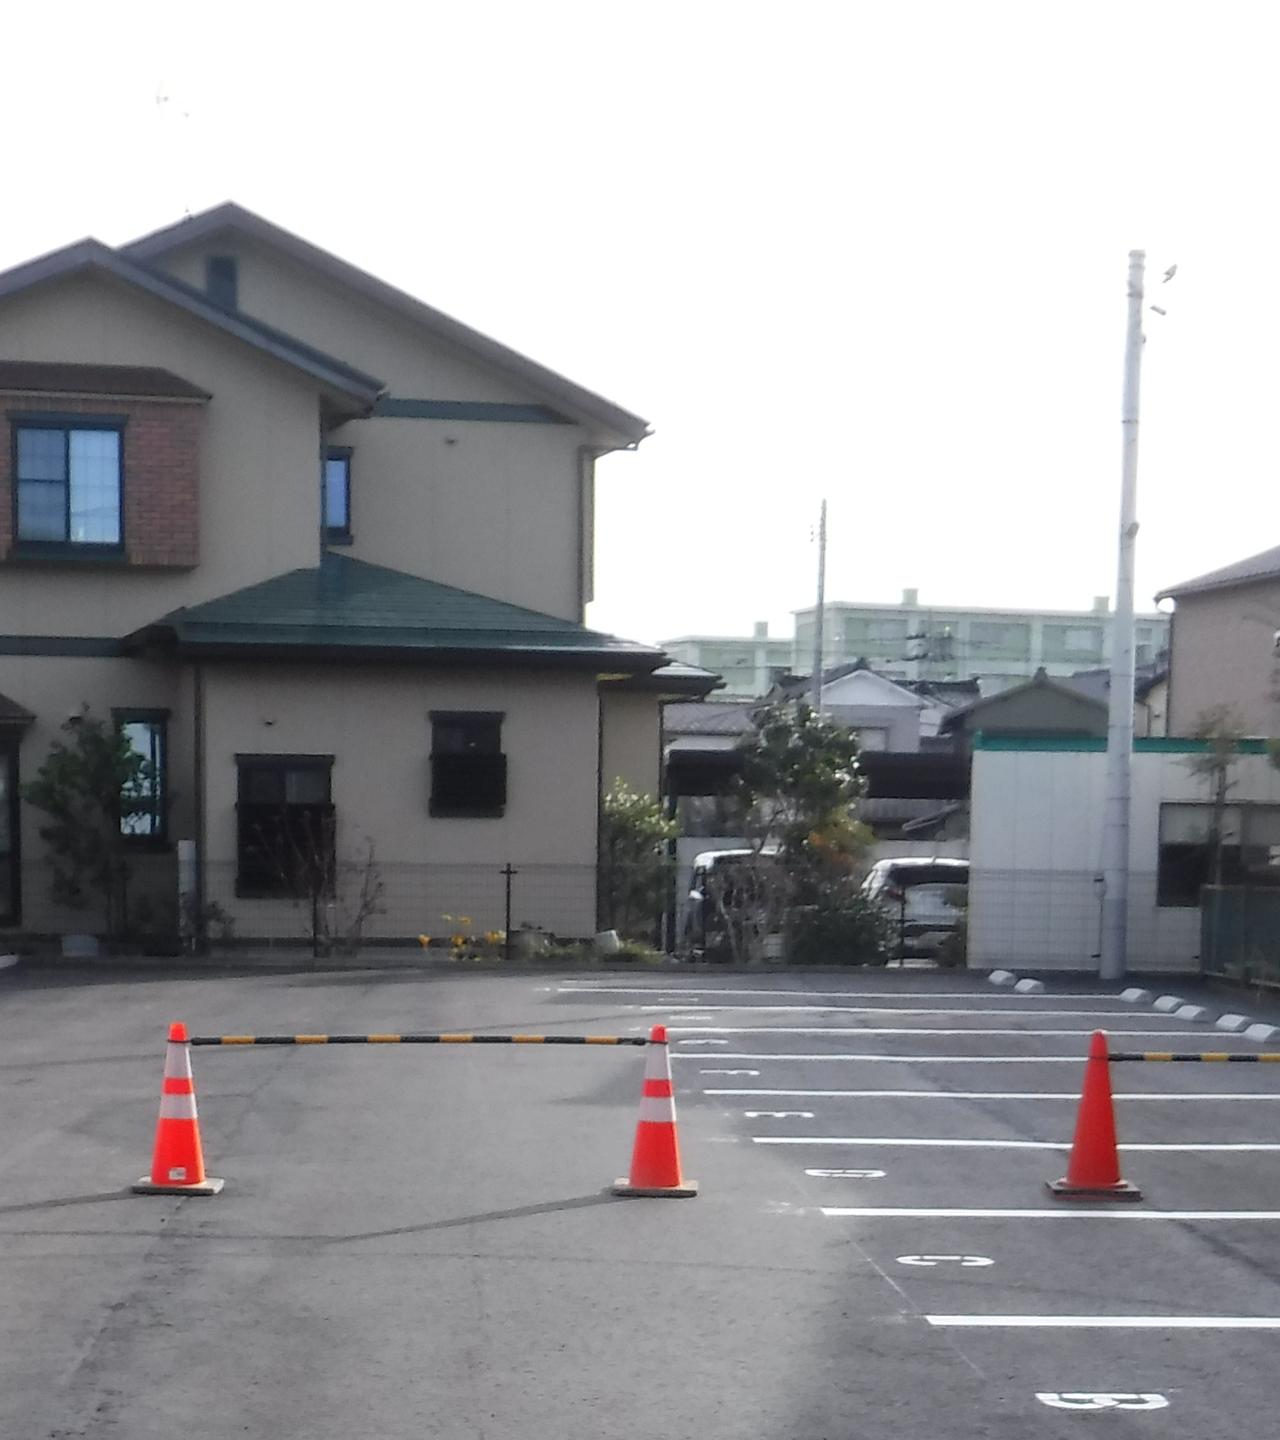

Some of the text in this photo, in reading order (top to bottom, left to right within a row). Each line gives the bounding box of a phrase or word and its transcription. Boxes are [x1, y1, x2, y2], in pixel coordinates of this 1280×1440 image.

[804, 1168, 887, 1178] D
[895, 1254, 995, 1267] C
[1034, 1391, 1170, 1410] B
